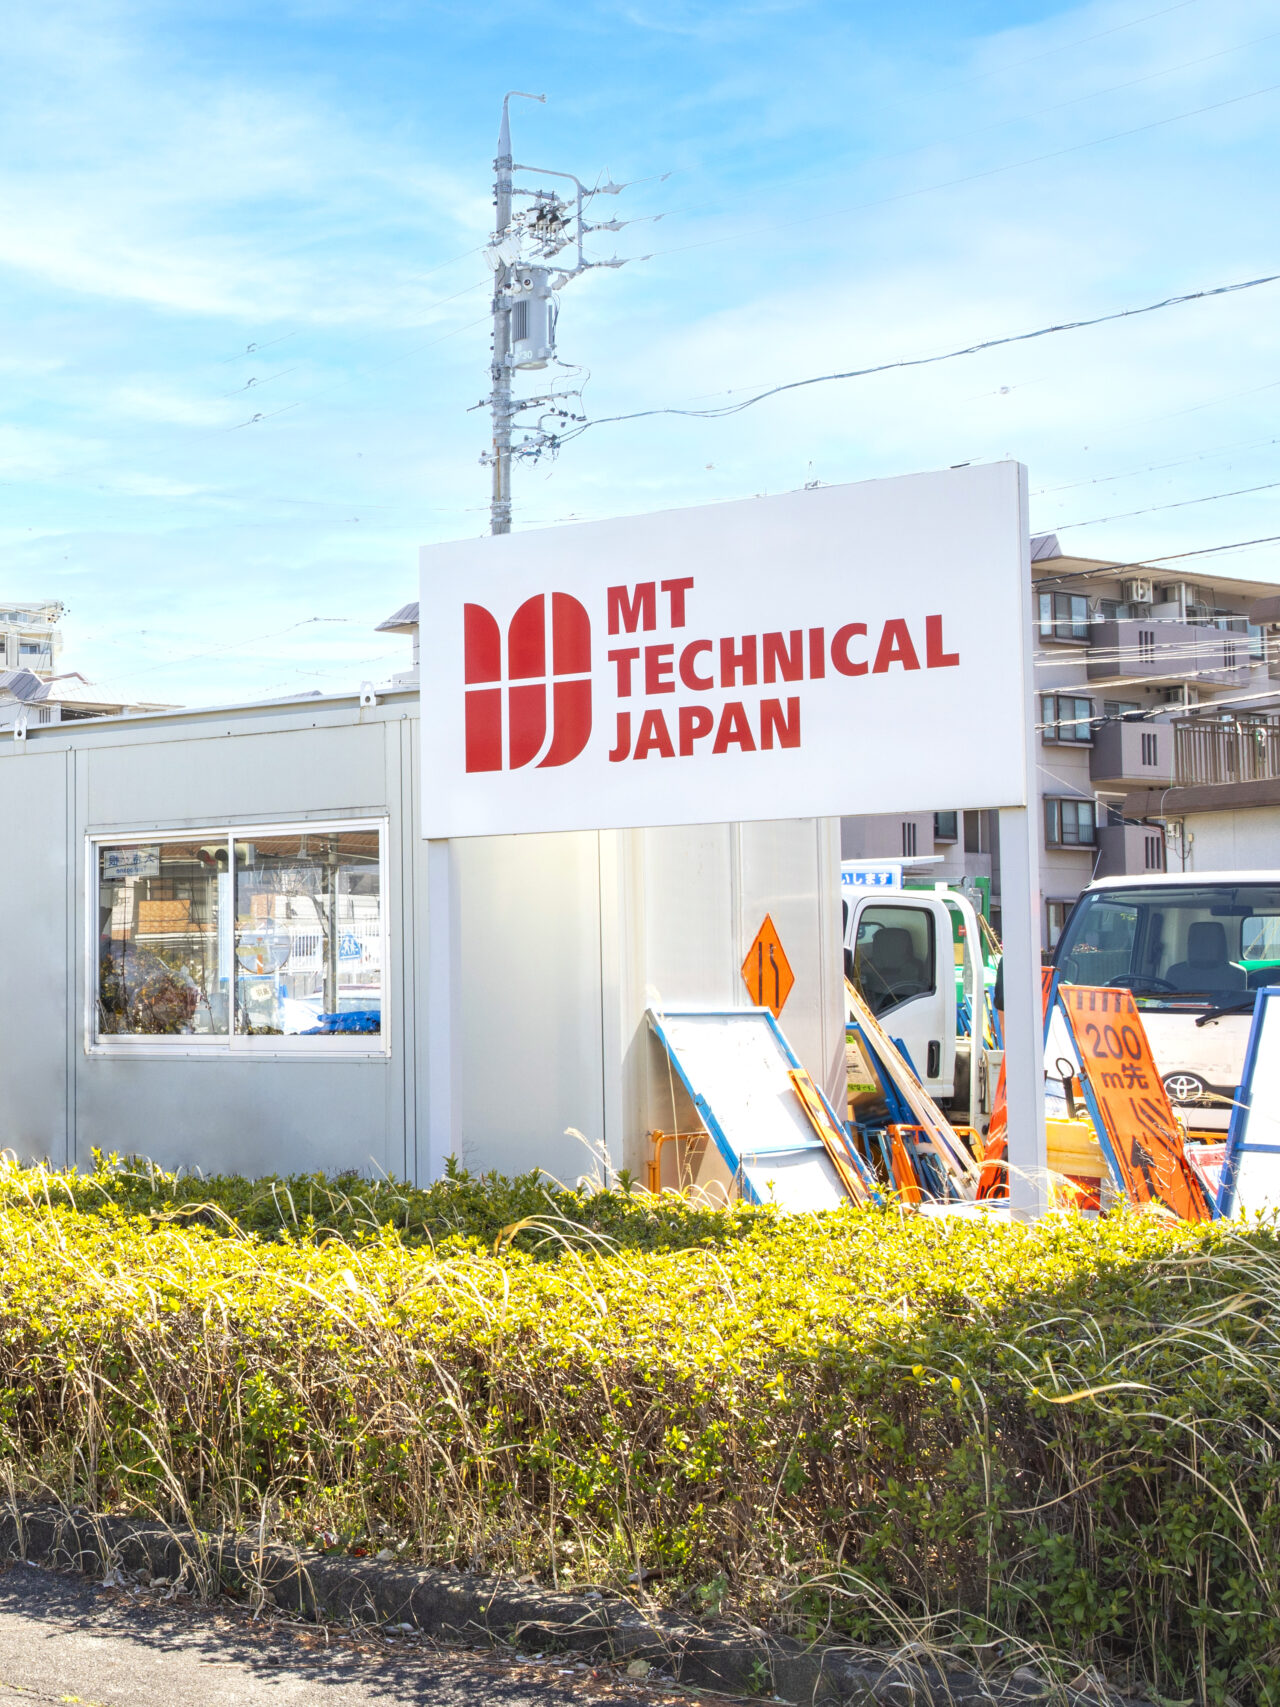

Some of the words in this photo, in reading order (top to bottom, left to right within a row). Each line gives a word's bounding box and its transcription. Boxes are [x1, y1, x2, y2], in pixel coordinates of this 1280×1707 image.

[608, 578, 693, 635] MT
[608, 615, 959, 697] TECHNICAL
[608, 697, 800, 762] JAPAN
[1086, 1023, 1141, 1060] 200
[1101, 1063, 1149, 1089] m先
